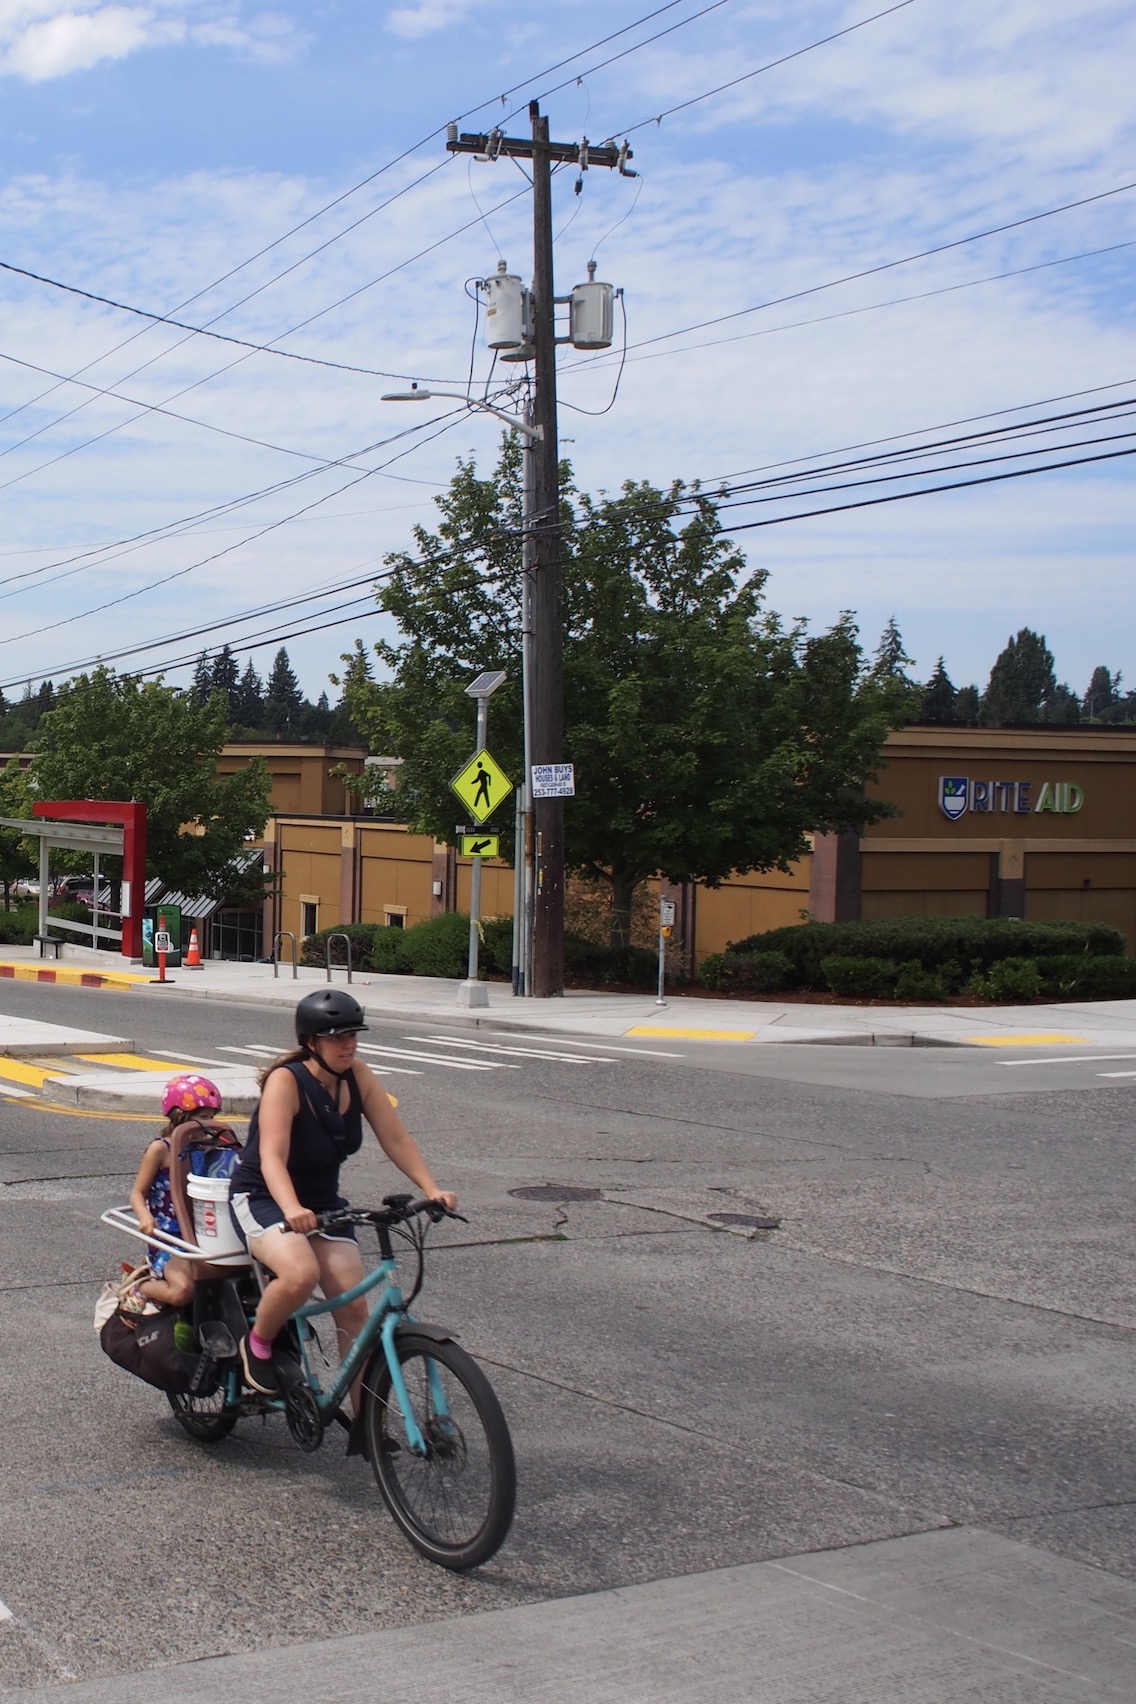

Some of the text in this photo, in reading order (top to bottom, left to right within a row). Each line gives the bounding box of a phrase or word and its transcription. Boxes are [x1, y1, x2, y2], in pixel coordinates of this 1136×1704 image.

[533, 764, 573, 774] JOHN BUYS
[535, 773, 571, 782] HOUSES & LAND
[534, 787, 573, 796] 253-777-4928
[969, 780, 1084, 813] RITE AID
